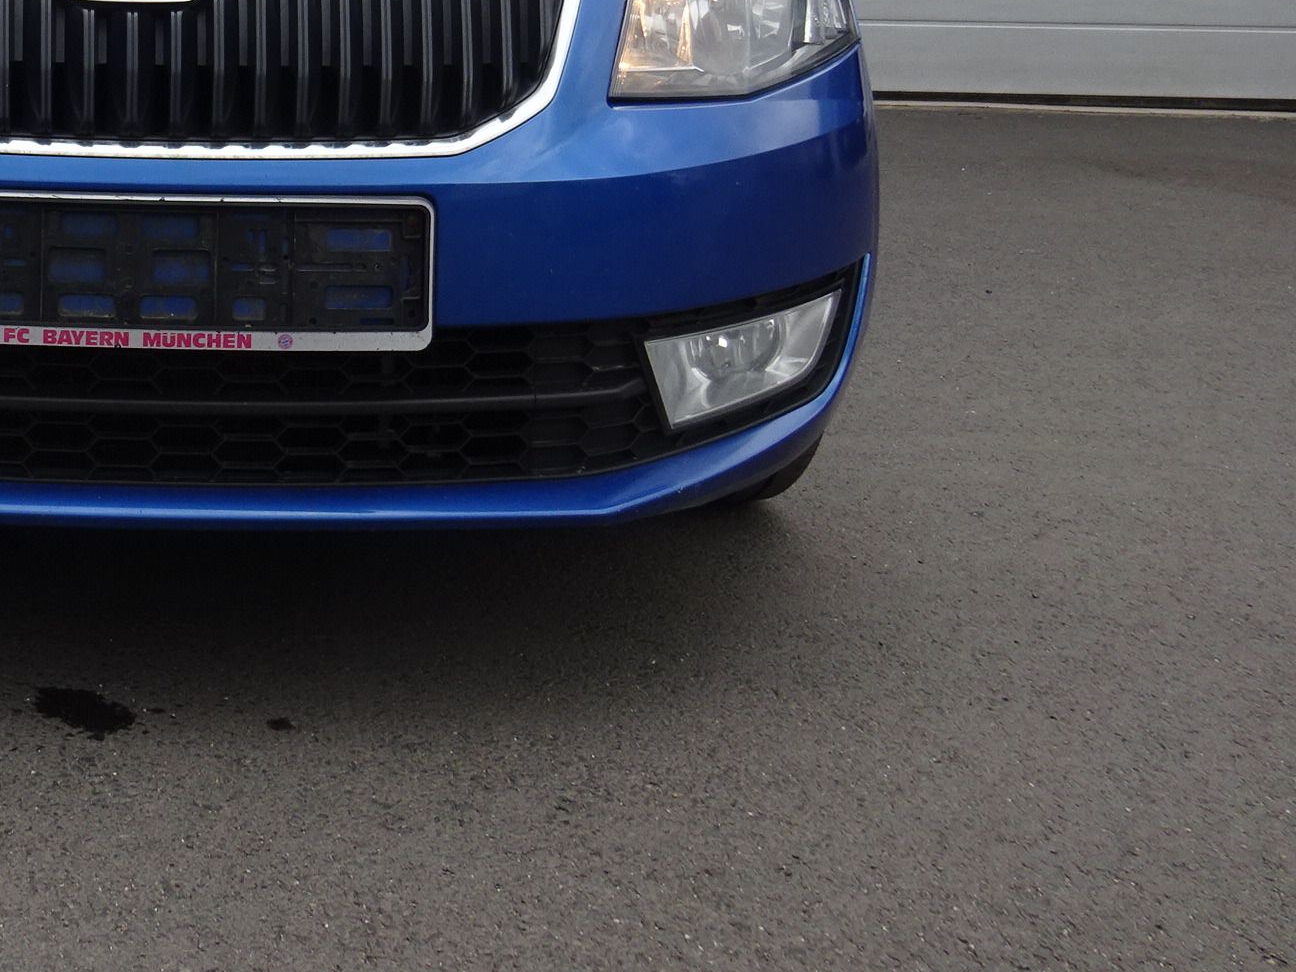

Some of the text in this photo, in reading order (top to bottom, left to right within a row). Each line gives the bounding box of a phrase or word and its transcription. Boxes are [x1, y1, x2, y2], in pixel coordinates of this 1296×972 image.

[3, 328, 252, 349] FC BAYERN MÜNCHEN
